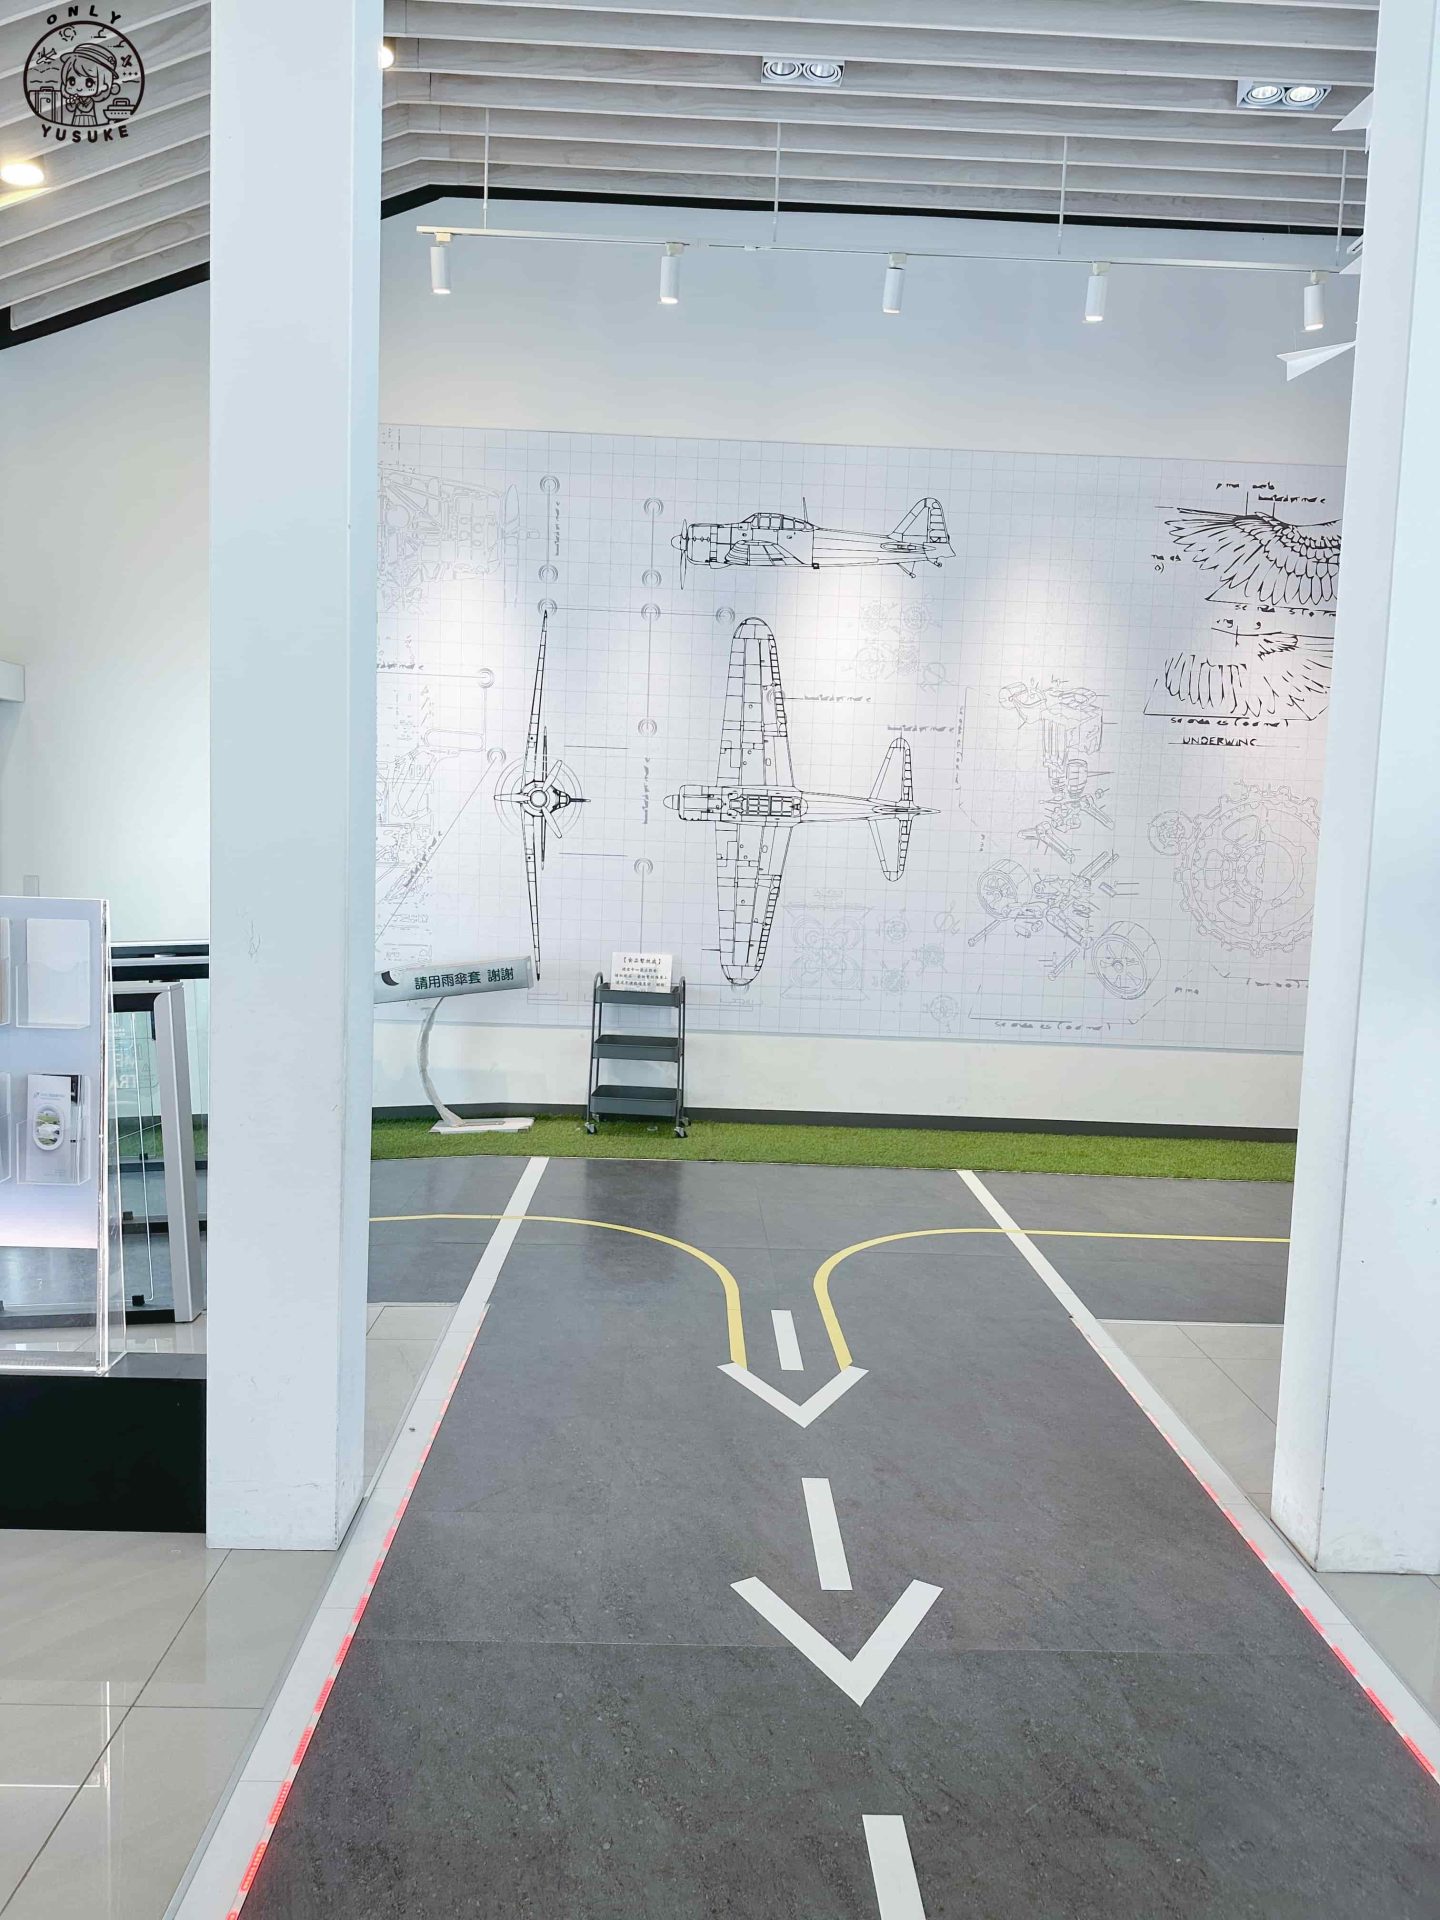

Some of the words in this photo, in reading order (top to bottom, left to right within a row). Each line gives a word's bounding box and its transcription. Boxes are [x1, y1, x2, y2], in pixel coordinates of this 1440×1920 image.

[414, 970, 482, 990] 請用雨傘套
[487, 967, 514, 983] 謝謝
